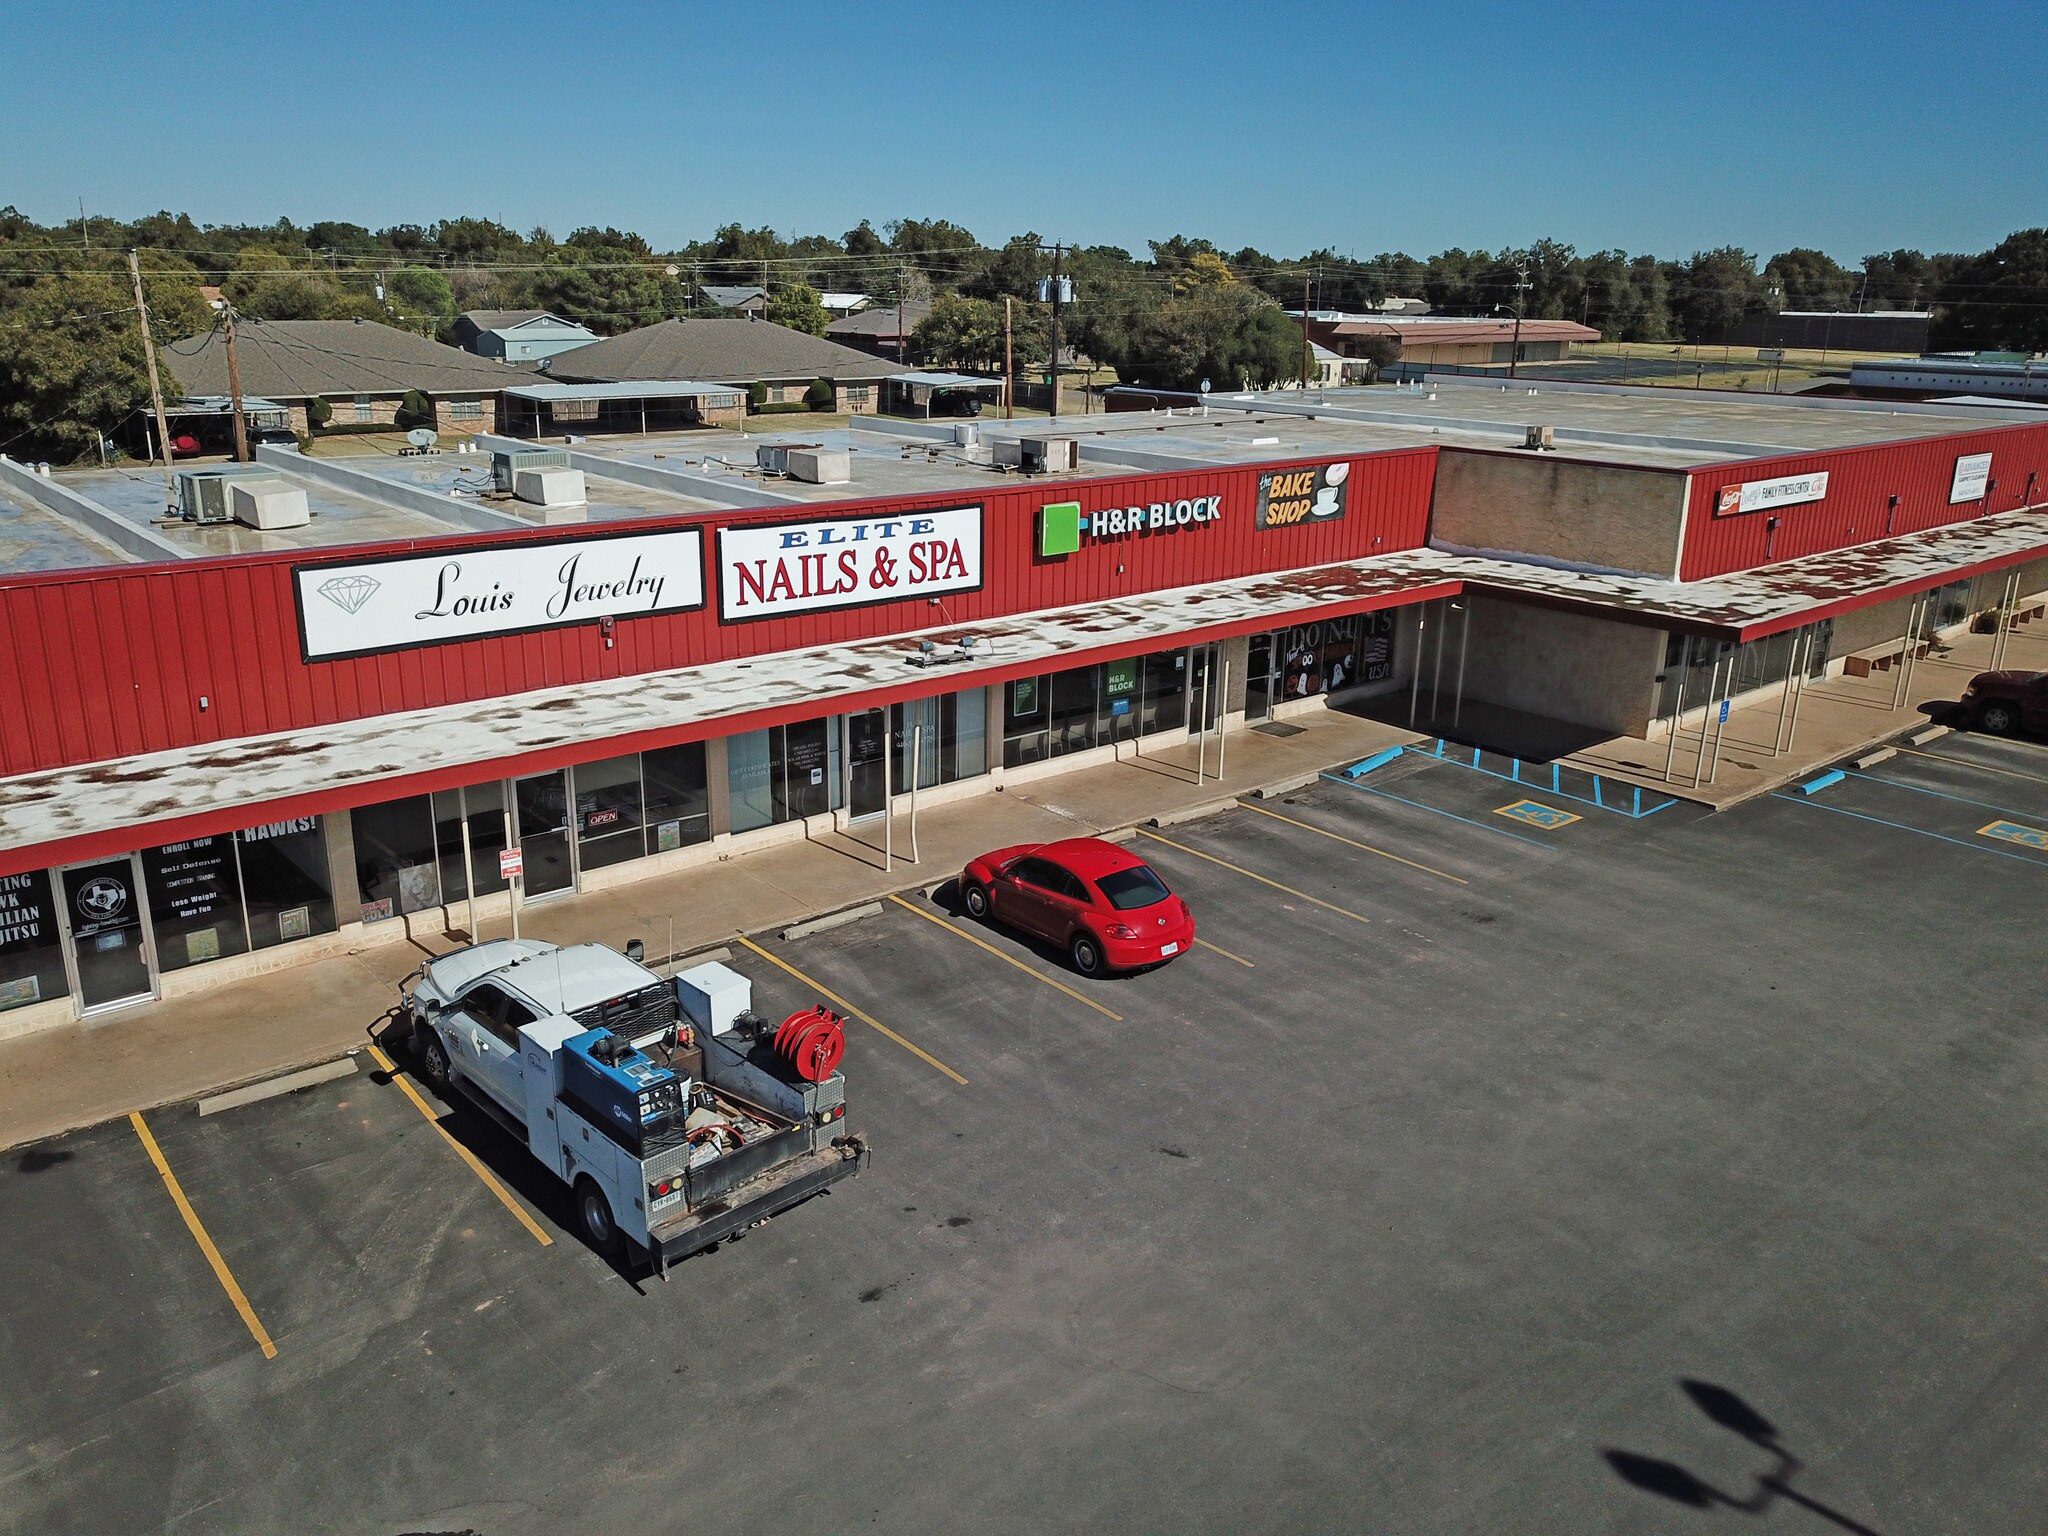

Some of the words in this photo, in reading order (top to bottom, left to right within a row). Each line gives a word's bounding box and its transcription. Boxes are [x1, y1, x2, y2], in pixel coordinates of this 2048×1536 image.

[1259, 472, 1272, 491] the
[1268, 471, 1316, 499] BAKE
[1091, 506, 1141, 537] H&R
[1149, 496, 1222, 530] BLOCK
[1265, 499, 1312, 525] SHOP
[779, 518, 936, 549] ELITE
[733, 549, 859, 606] NAILS
[869, 546, 898, 589] &
[908, 537, 969, 584] SPA
[415, 561, 515, 620] Louis
[546, 551, 666, 619] Jewelry
[1109, 674, 1126, 684] H&R
[1369, 663, 1389, 680] USA
[1108, 680, 1134, 693] BLOCK
[590, 812, 616, 826] OPEN
[244, 815, 317, 843] HAWKS!
[162, 842, 190, 855] ENROLL
[193, 837, 213, 849] NOW
[160, 865, 180, 875] Self
[182, 857, 222, 870] Defense
[171, 898, 189, 908] Lose
[190, 891, 217, 903] Weight
[180, 908, 197, 918] Have
[199, 904, 212, 914] Fun
